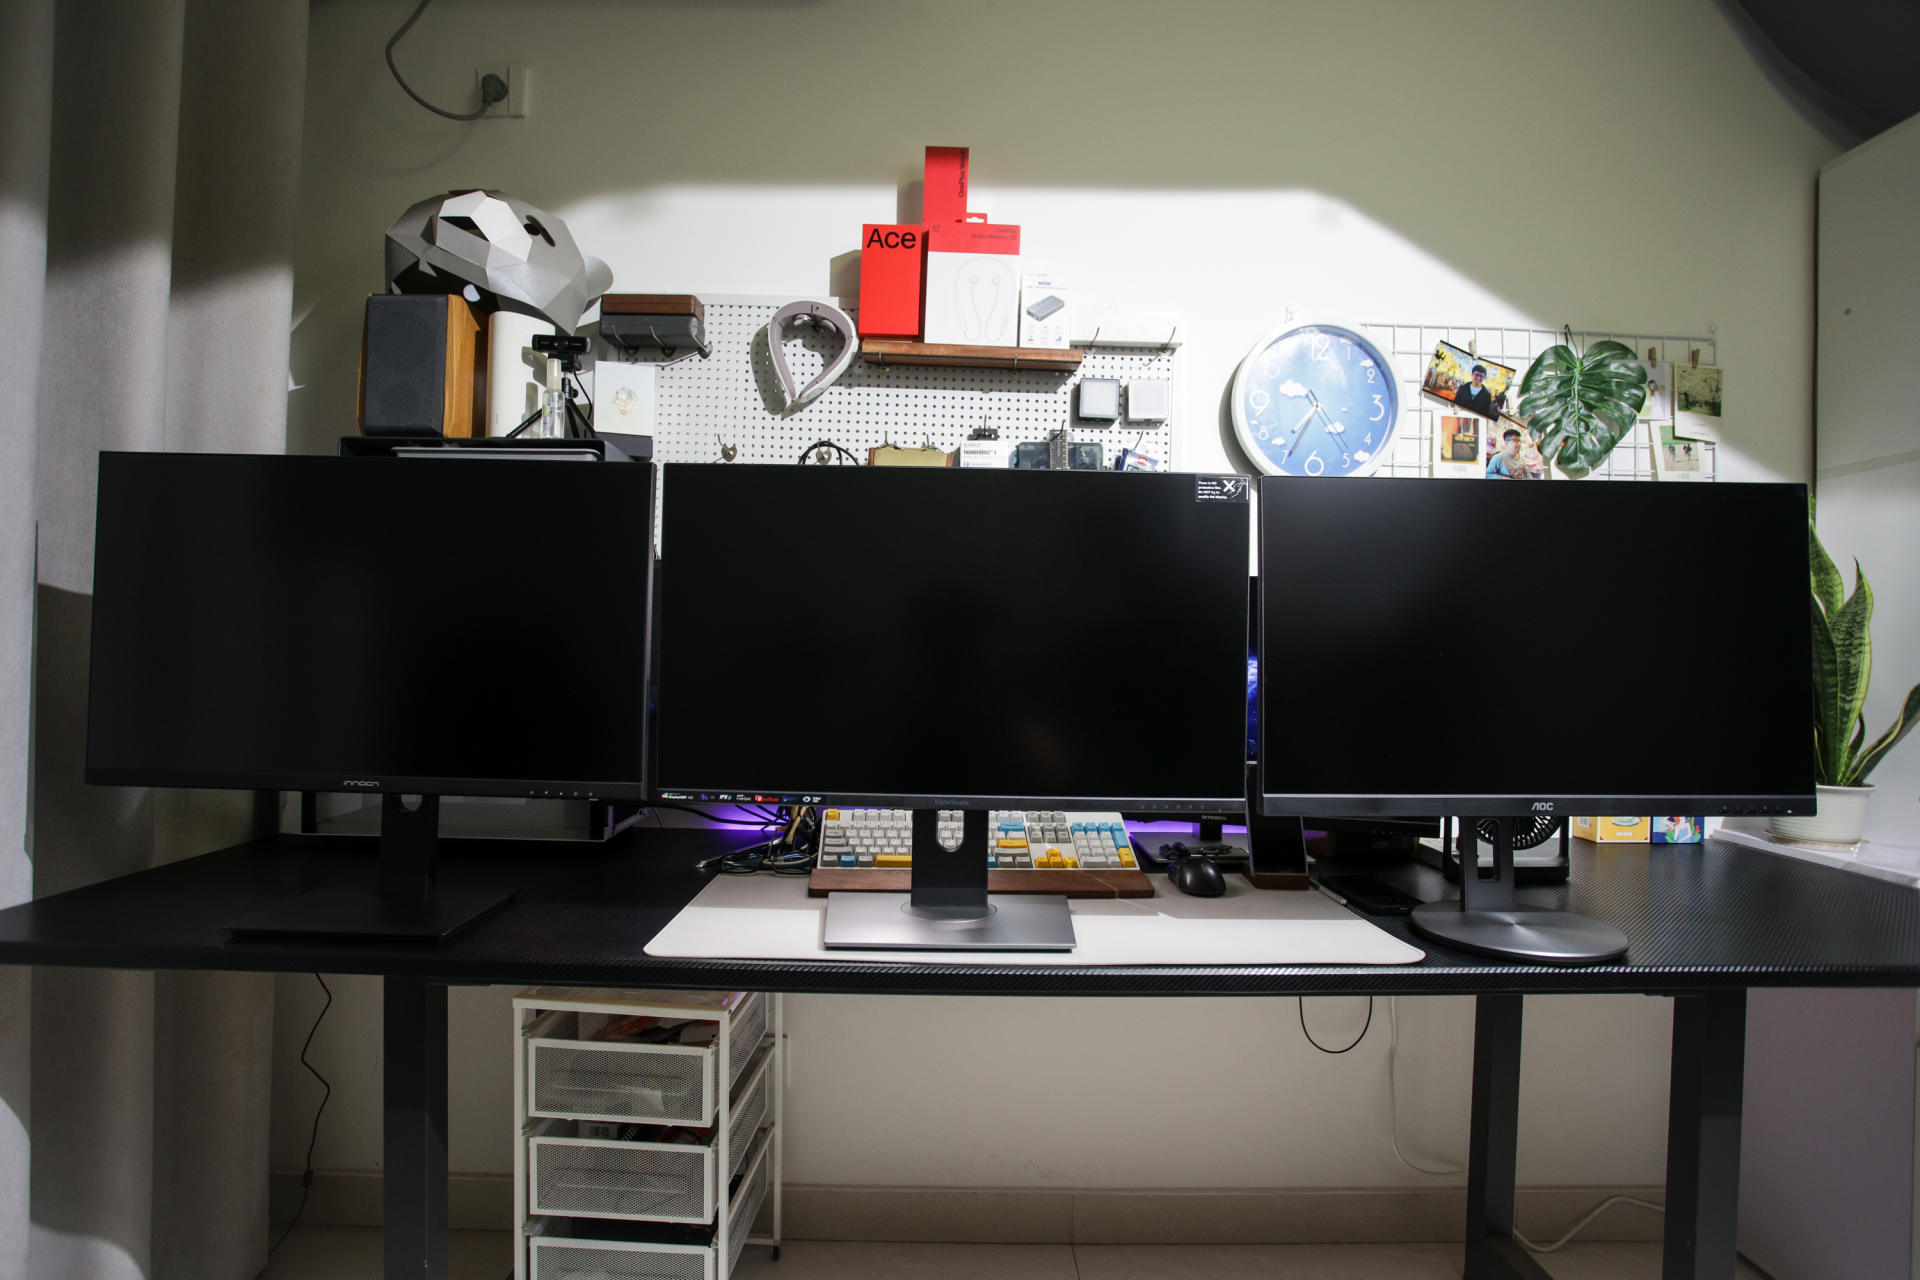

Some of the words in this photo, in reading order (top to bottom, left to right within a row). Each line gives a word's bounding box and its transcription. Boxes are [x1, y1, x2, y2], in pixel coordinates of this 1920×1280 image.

[866, 228, 917, 249] Ace
[1311, 337, 1330, 361] 12
[1346, 345, 1351, 360] 1
[1366, 368, 1376, 383] 2
[1249, 389, 1270, 416] 9
[1369, 394, 1385, 421] 3
[1258, 425, 1269, 441] 8
[1364, 432, 1372, 445] 4
[1281, 449, 1289, 465] 7
[1304, 450, 1325, 476] 6
[1341, 453, 1351, 468] 5
[1531, 802, 1554, 811] AOC
